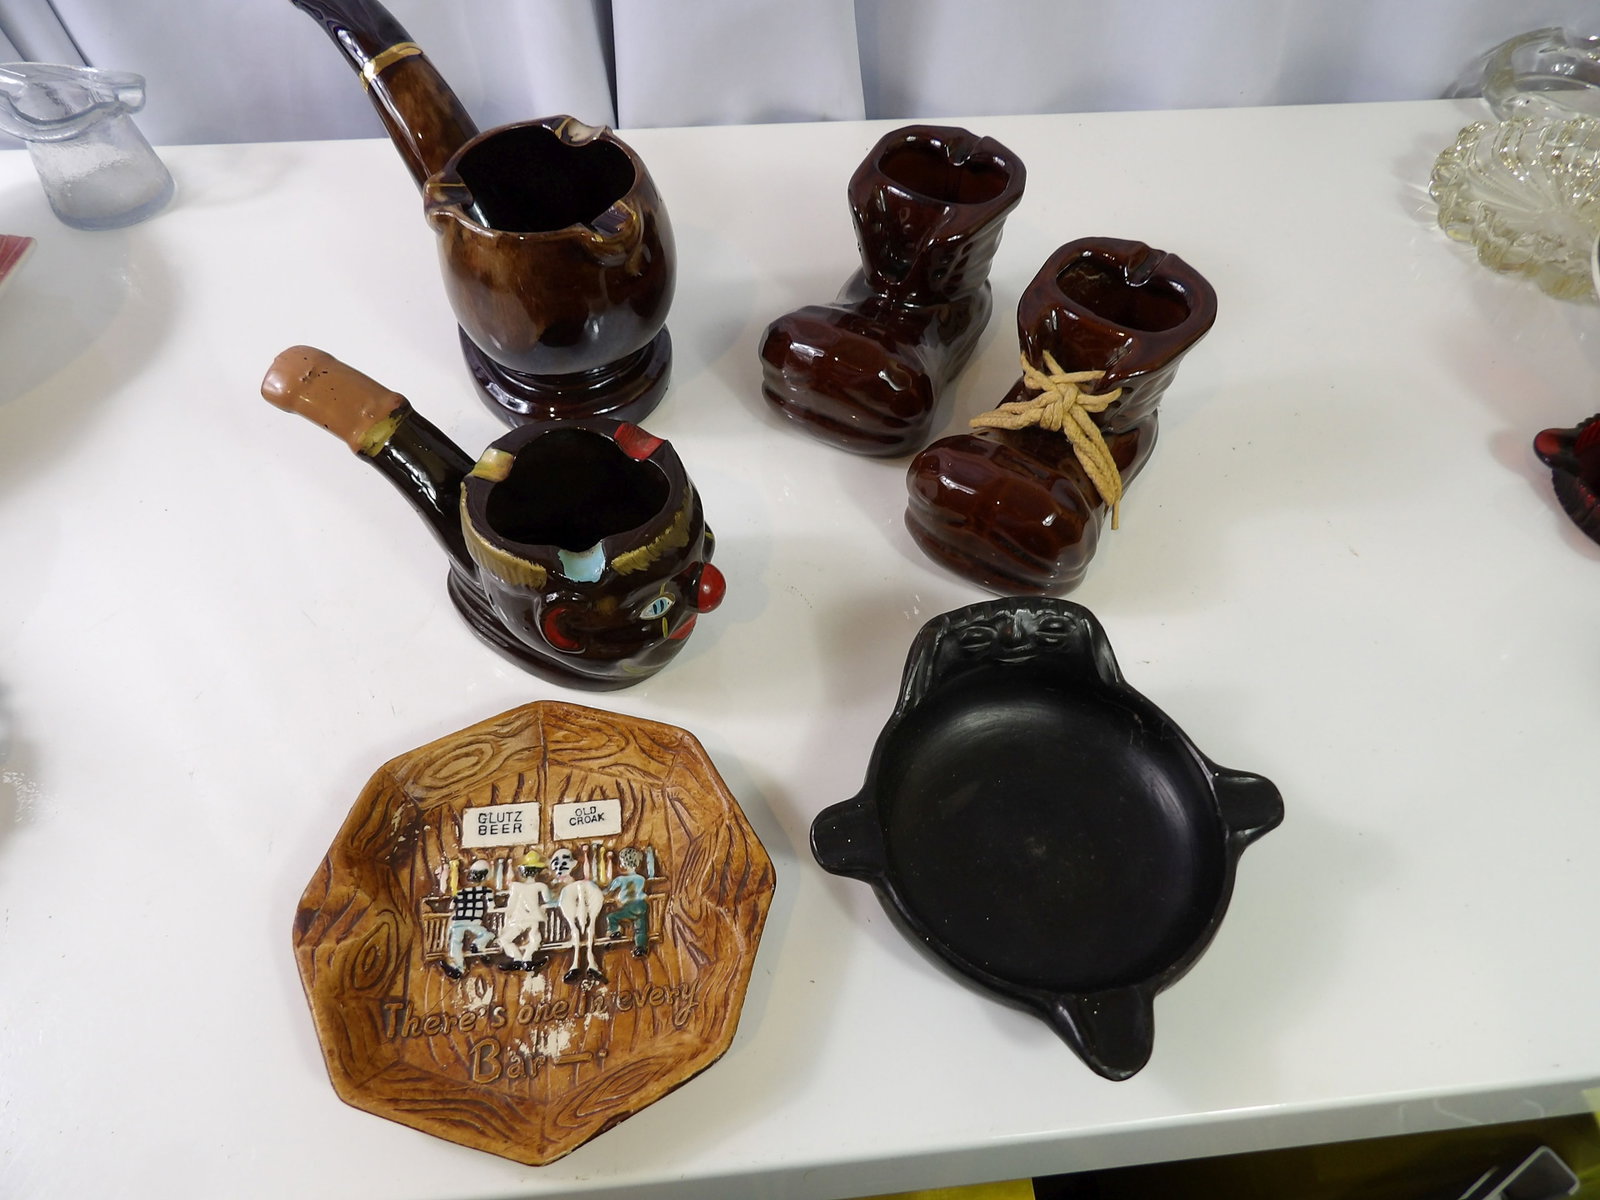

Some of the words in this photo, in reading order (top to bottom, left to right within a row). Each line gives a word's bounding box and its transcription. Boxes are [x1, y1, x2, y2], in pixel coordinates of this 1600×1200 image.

[478, 810, 523, 824] GLUTZ
[575, 806, 597, 817] OLD
[569, 812, 605, 826] CROAK
[478, 823, 523, 835] BEER
[517, 1000, 569, 1025] one
[616, 978, 700, 1029] every
